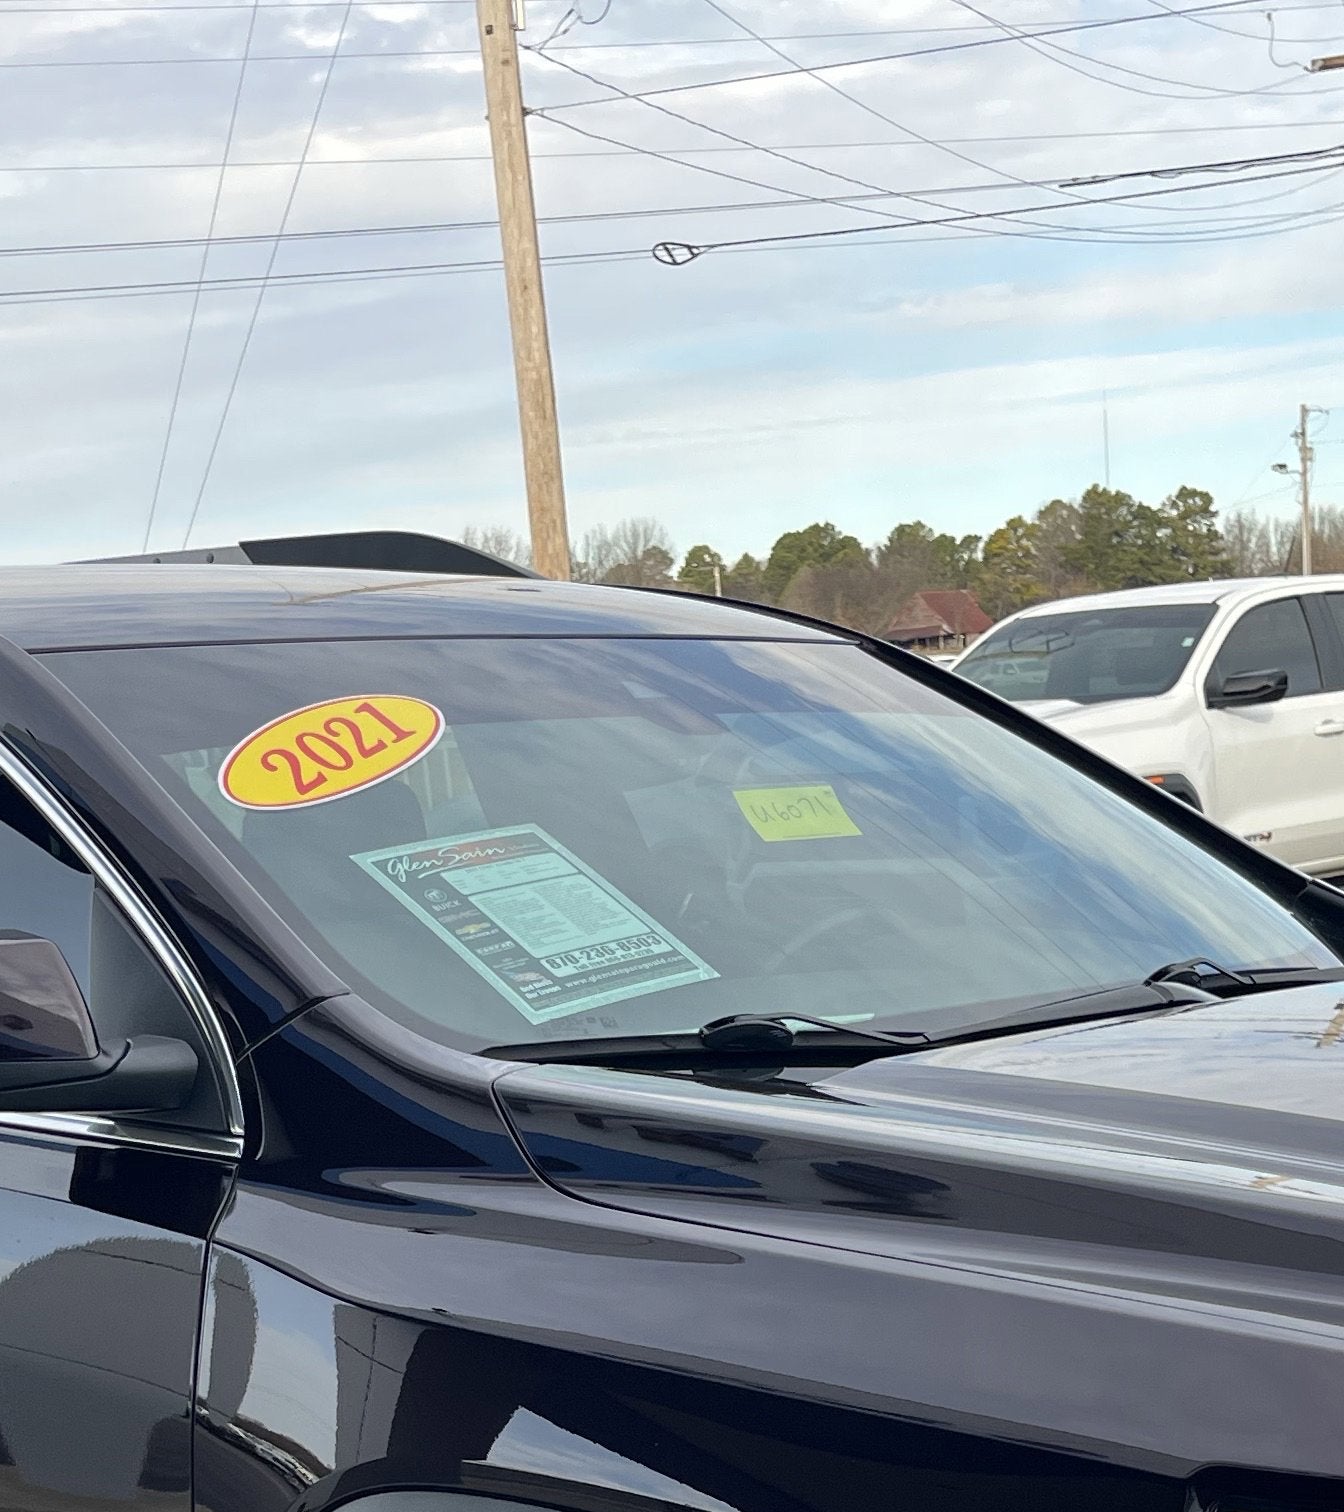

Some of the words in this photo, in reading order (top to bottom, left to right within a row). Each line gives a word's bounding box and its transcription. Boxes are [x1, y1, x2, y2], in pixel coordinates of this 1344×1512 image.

[260, 702, 417, 796] 2021
[387, 855, 443, 882] Glen
[438, 847, 506, 865] Sain
